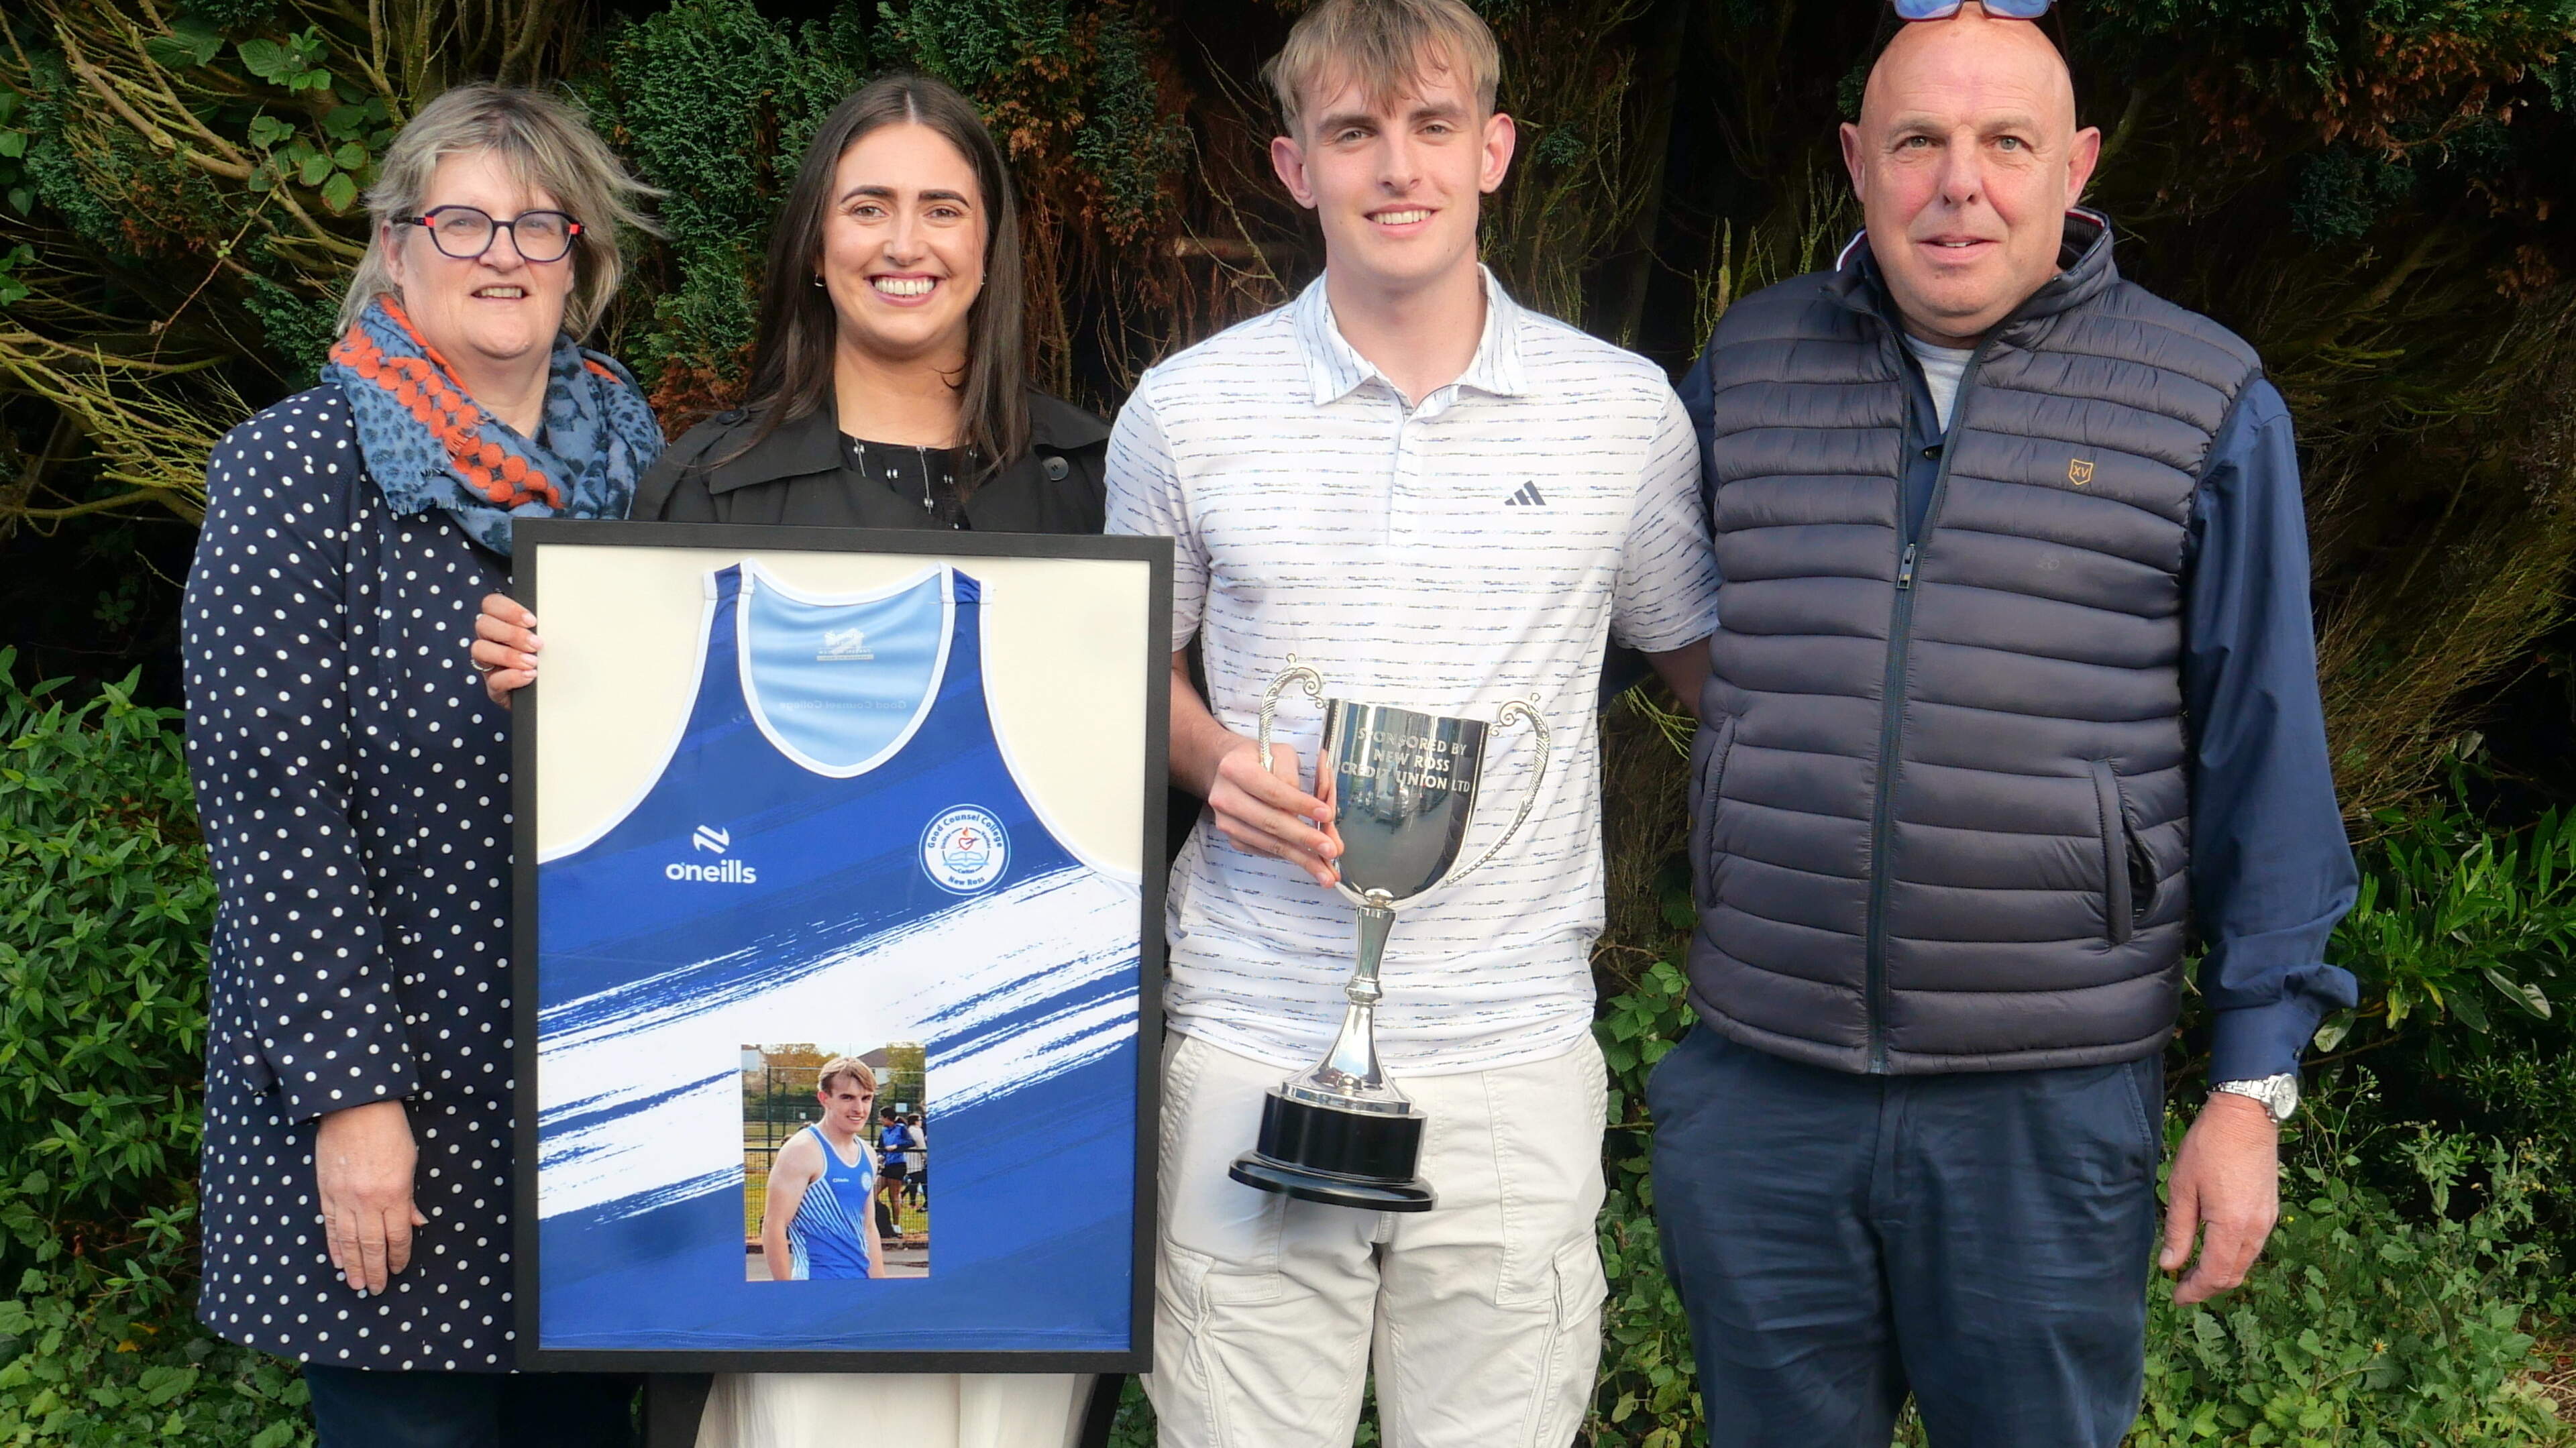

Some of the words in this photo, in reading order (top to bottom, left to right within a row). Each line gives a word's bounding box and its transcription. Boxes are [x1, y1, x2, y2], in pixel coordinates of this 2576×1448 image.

[2072, 465, 2089, 478] XV
[1451, 742, 1467, 756] BY
[1373, 748, 1409, 766] NEW
[1413, 755, 1450, 772] ROSS
[1341, 761, 1387, 779] CREDIT
[1395, 770, 1448, 790] UNION
[1451, 779, 1470, 793] LTD
[927, 824, 943, 848] Good
[943, 814, 981, 826] Counsel
[981, 816, 1003, 848] College
[948, 875, 965, 886] New
[967, 876, 985, 886] Ross
